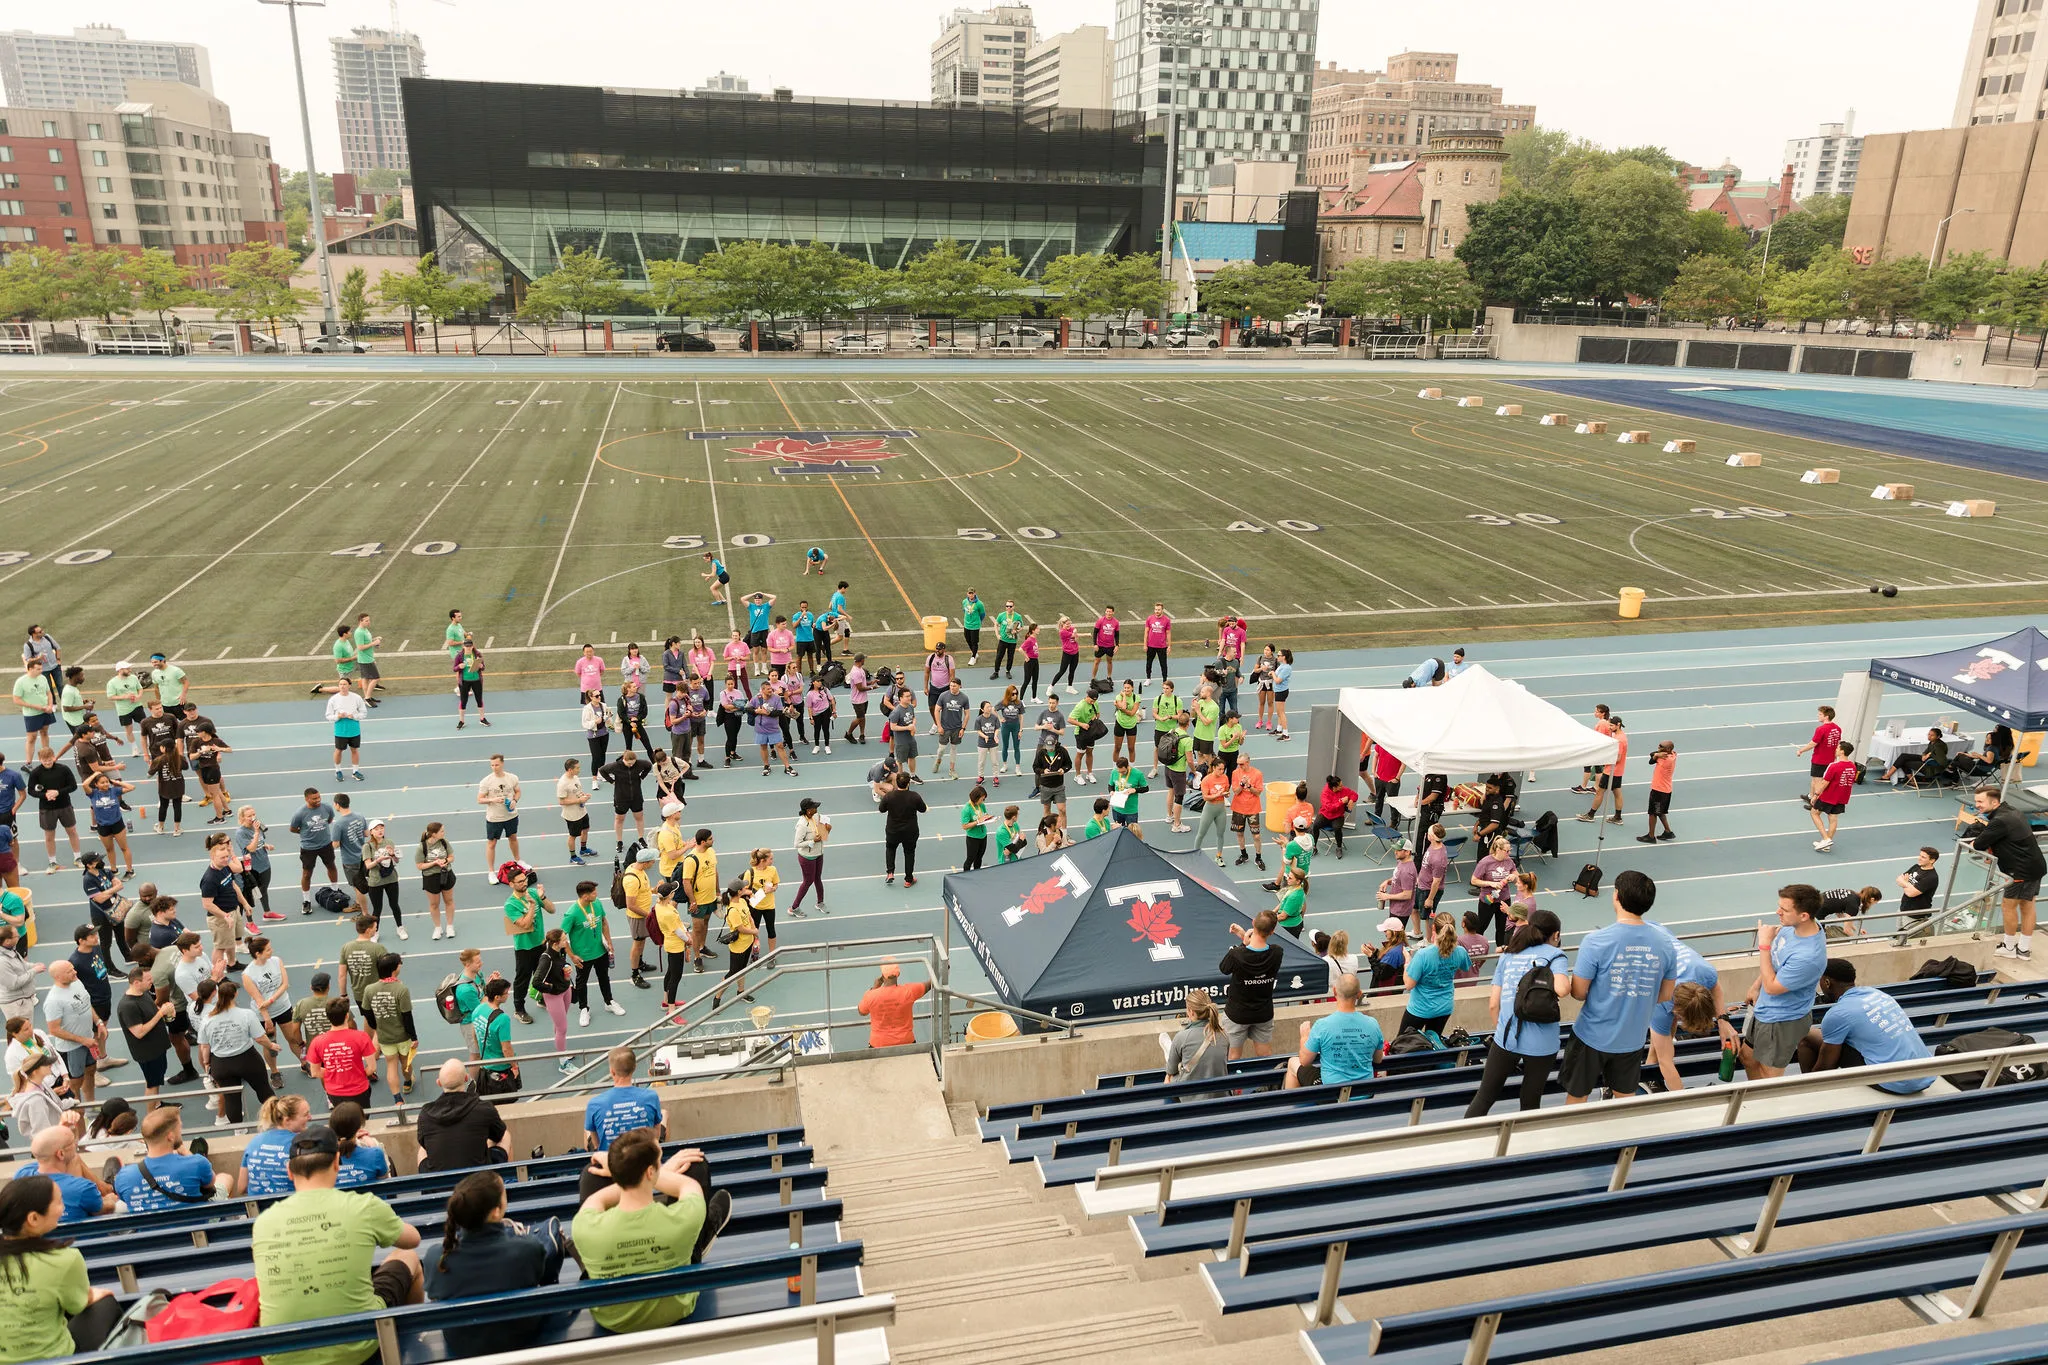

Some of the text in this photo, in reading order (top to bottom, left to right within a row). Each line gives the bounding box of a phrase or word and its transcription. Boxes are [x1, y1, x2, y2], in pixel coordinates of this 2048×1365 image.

[662, 532, 776, 549] 50
[957, 526, 1062, 542] 50
[329, 540, 459, 558] 40
[1910, 676, 1977, 707] varsityblues.ca
[1112, 983, 1231, 1011] varsitybles.c
